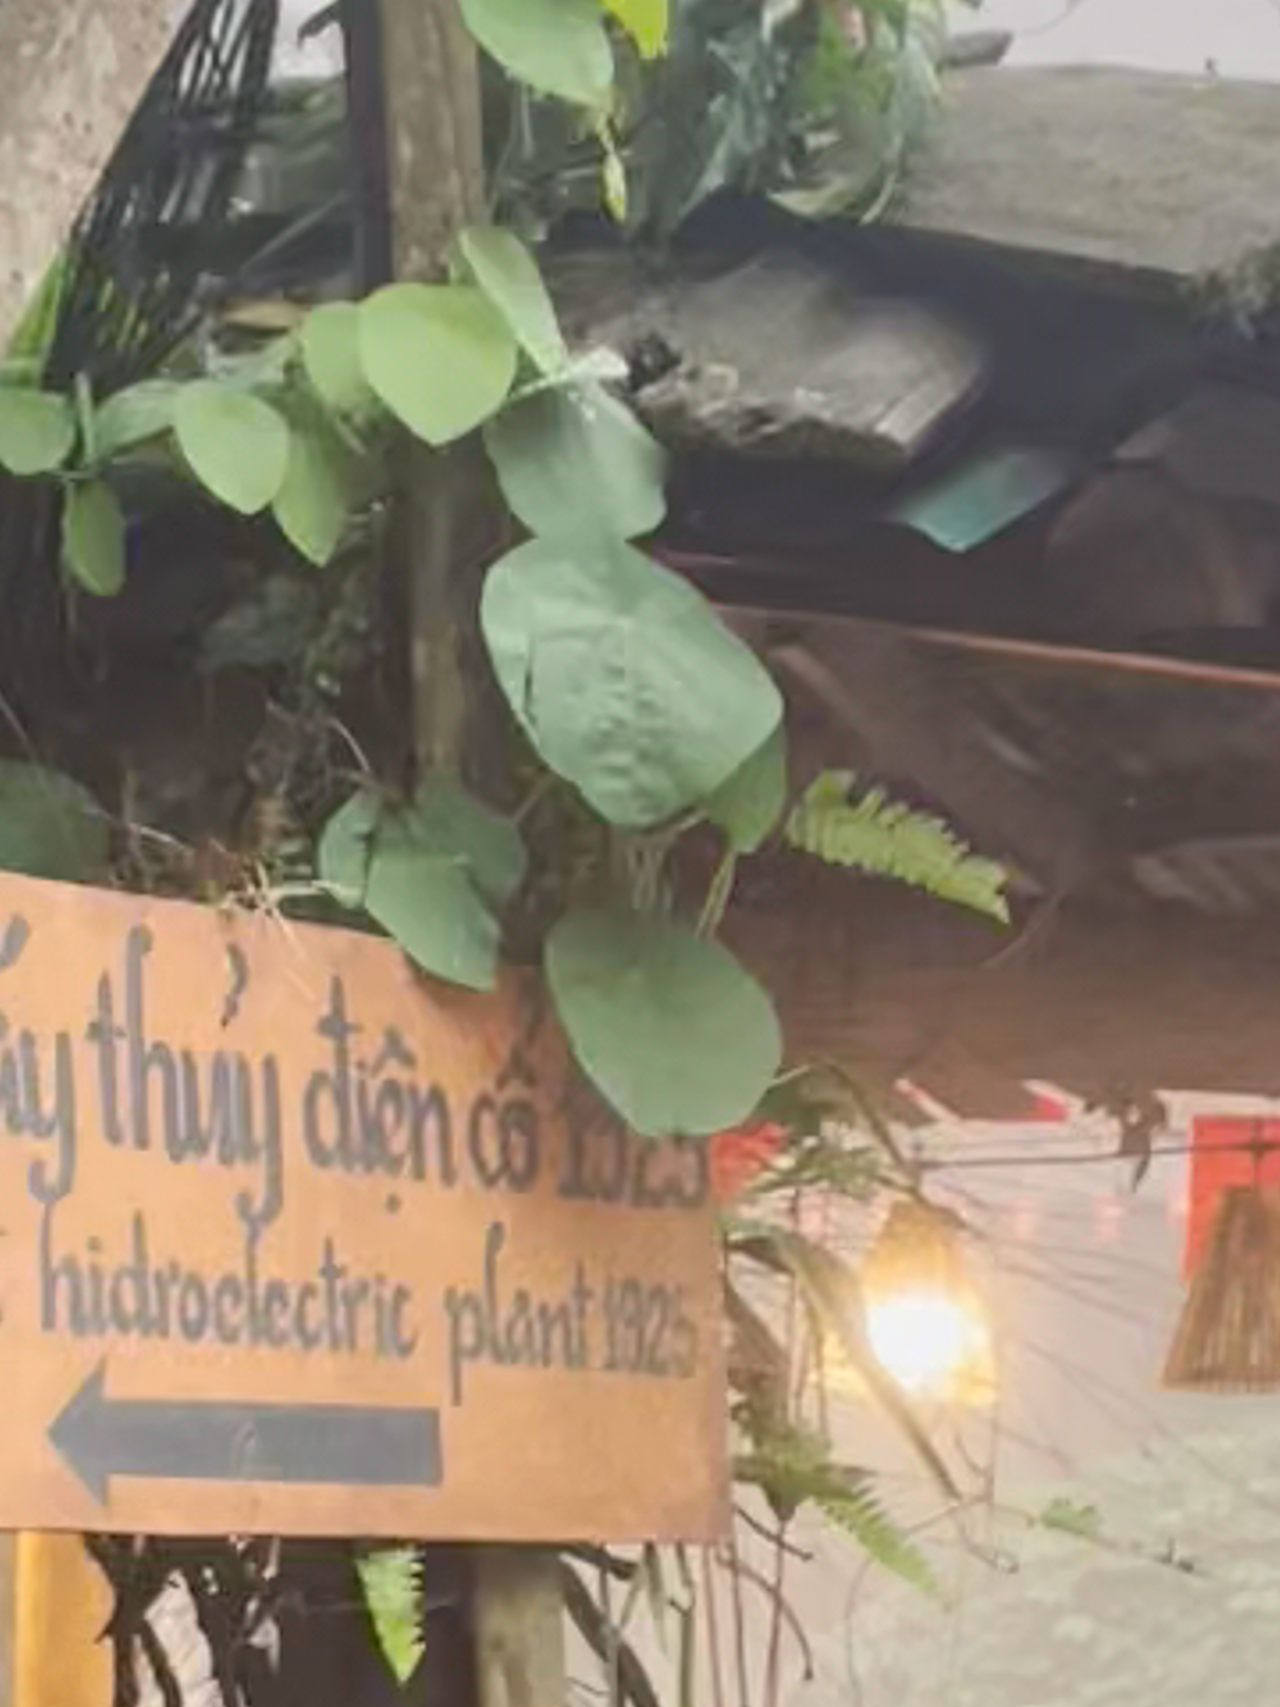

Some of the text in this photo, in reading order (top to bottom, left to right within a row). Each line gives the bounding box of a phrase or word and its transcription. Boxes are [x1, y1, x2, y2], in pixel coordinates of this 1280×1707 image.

[304, 975, 458, 1215] điện
[40, 1201, 418, 1357] hidroelectric
[443, 1221, 593, 1407] plant
